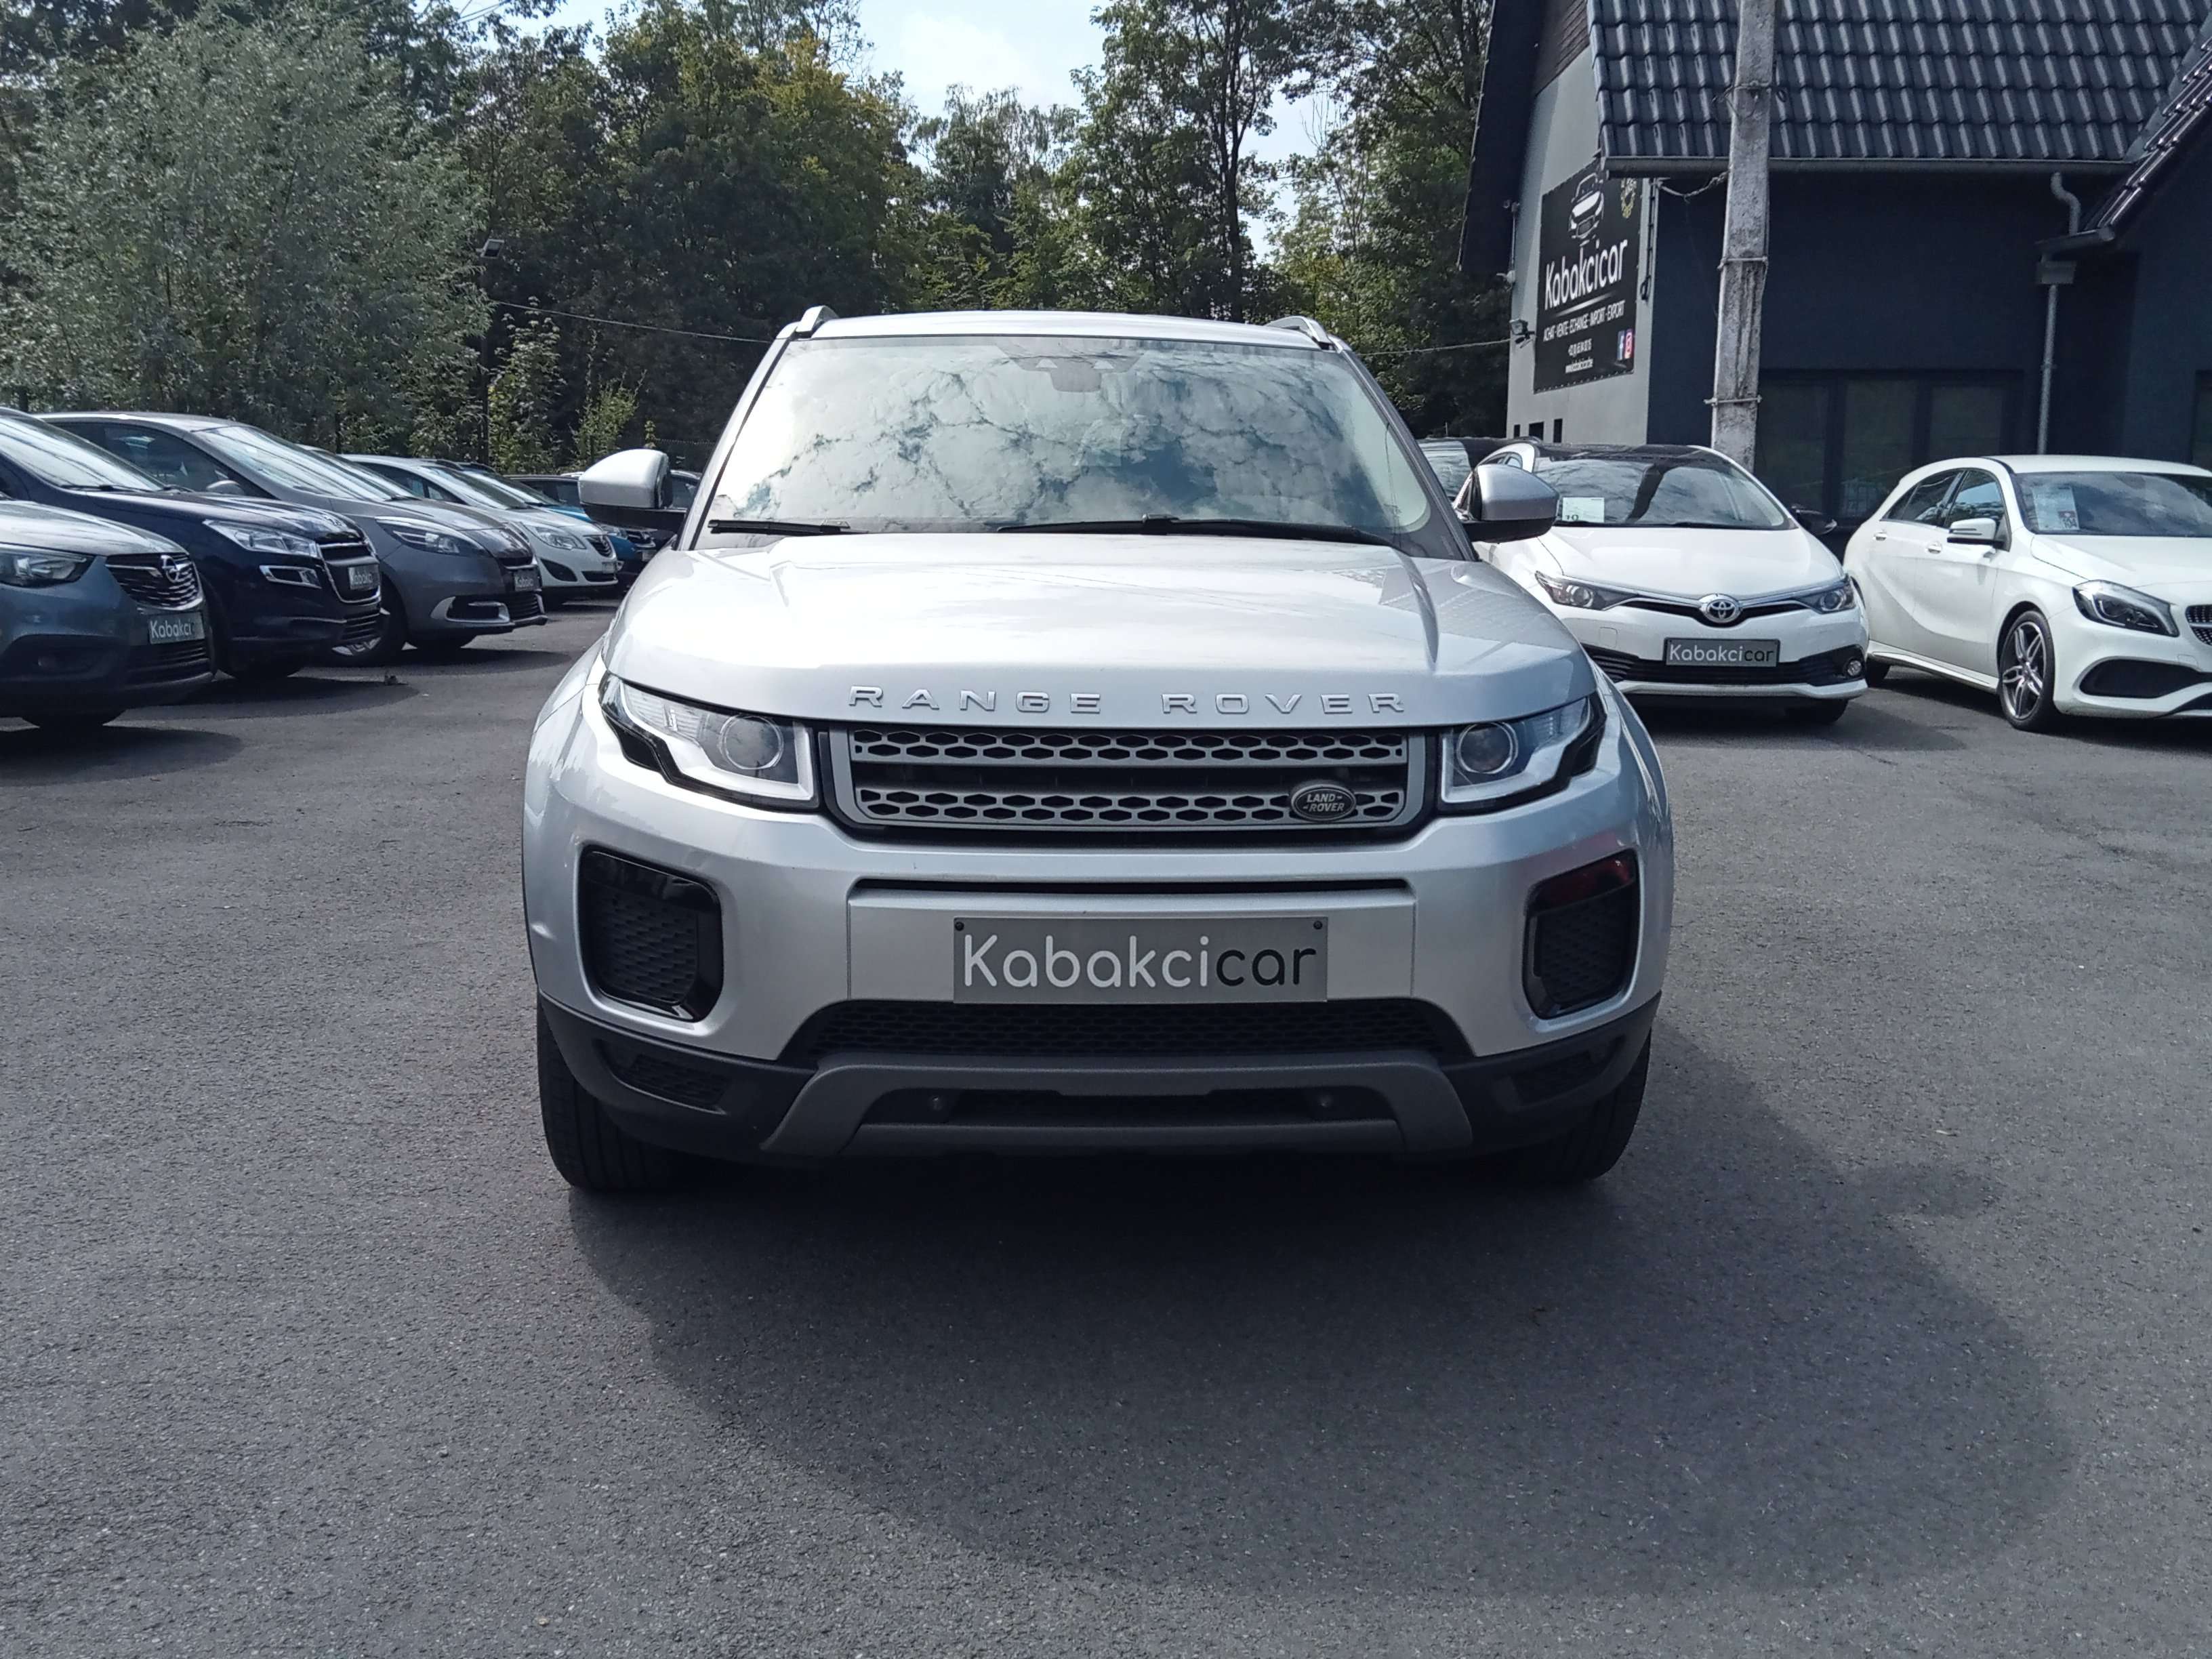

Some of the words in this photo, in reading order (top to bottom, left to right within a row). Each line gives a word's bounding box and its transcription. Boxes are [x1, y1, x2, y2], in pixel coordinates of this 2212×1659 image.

[1544, 239, 1628, 310] Kabakcicar
[1607, 300, 1626, 321] EXPORT
[150, 619, 197, 638] Kabakci
[1669, 644, 1775, 662] Kabakcicar
[848, 685, 1101, 714] RANGE
[1161, 693, 1405, 714] ROVER
[964, 934, 1317, 987] Kabakcicar
